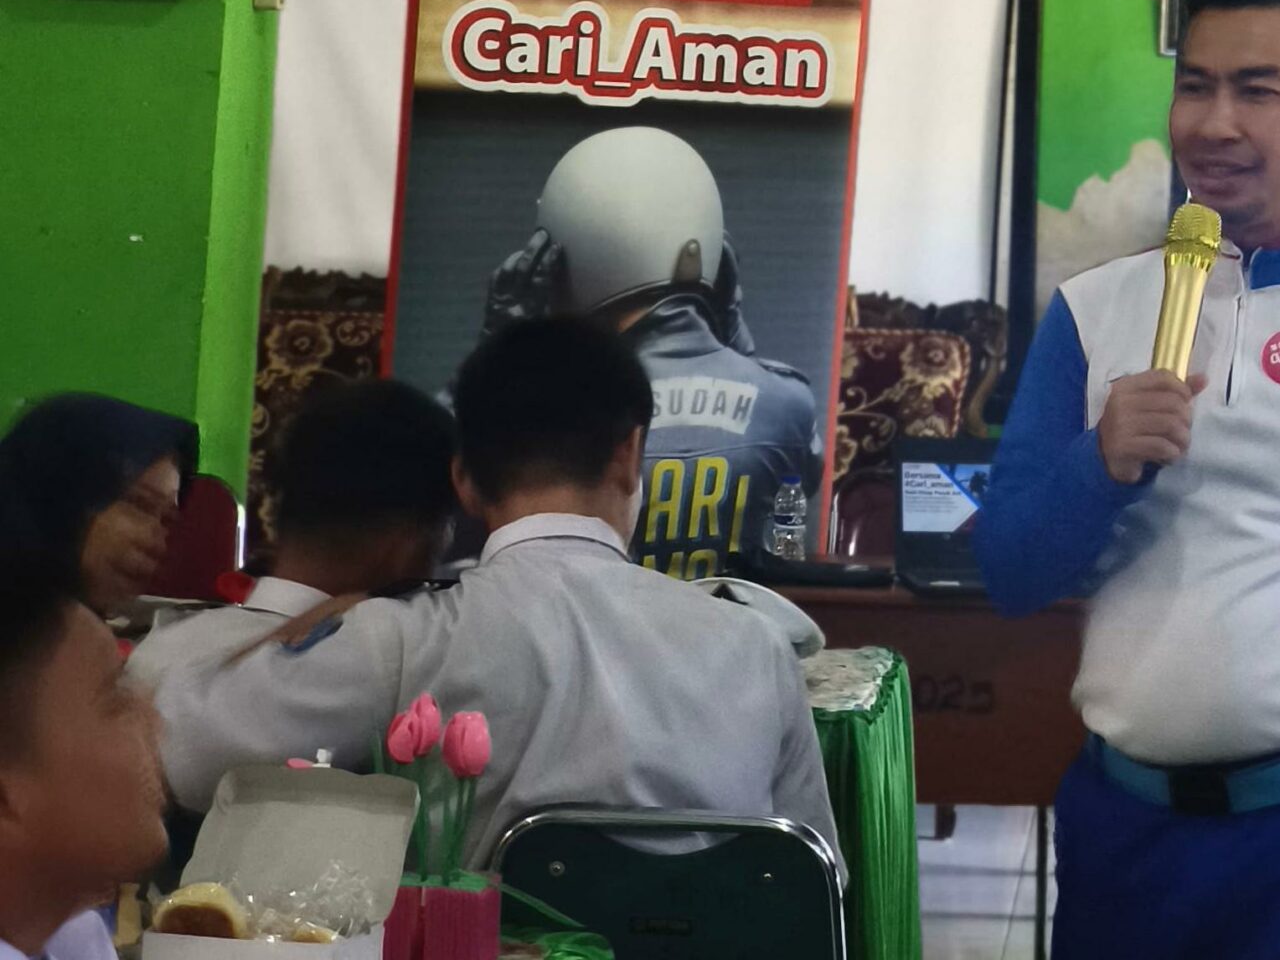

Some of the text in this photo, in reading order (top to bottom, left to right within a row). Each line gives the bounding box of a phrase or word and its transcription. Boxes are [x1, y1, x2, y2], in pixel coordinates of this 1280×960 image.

[462, 17, 821, 89] Cari_Aman
[651, 388, 753, 421] SUDAH
[645, 456, 751, 553] ARI
